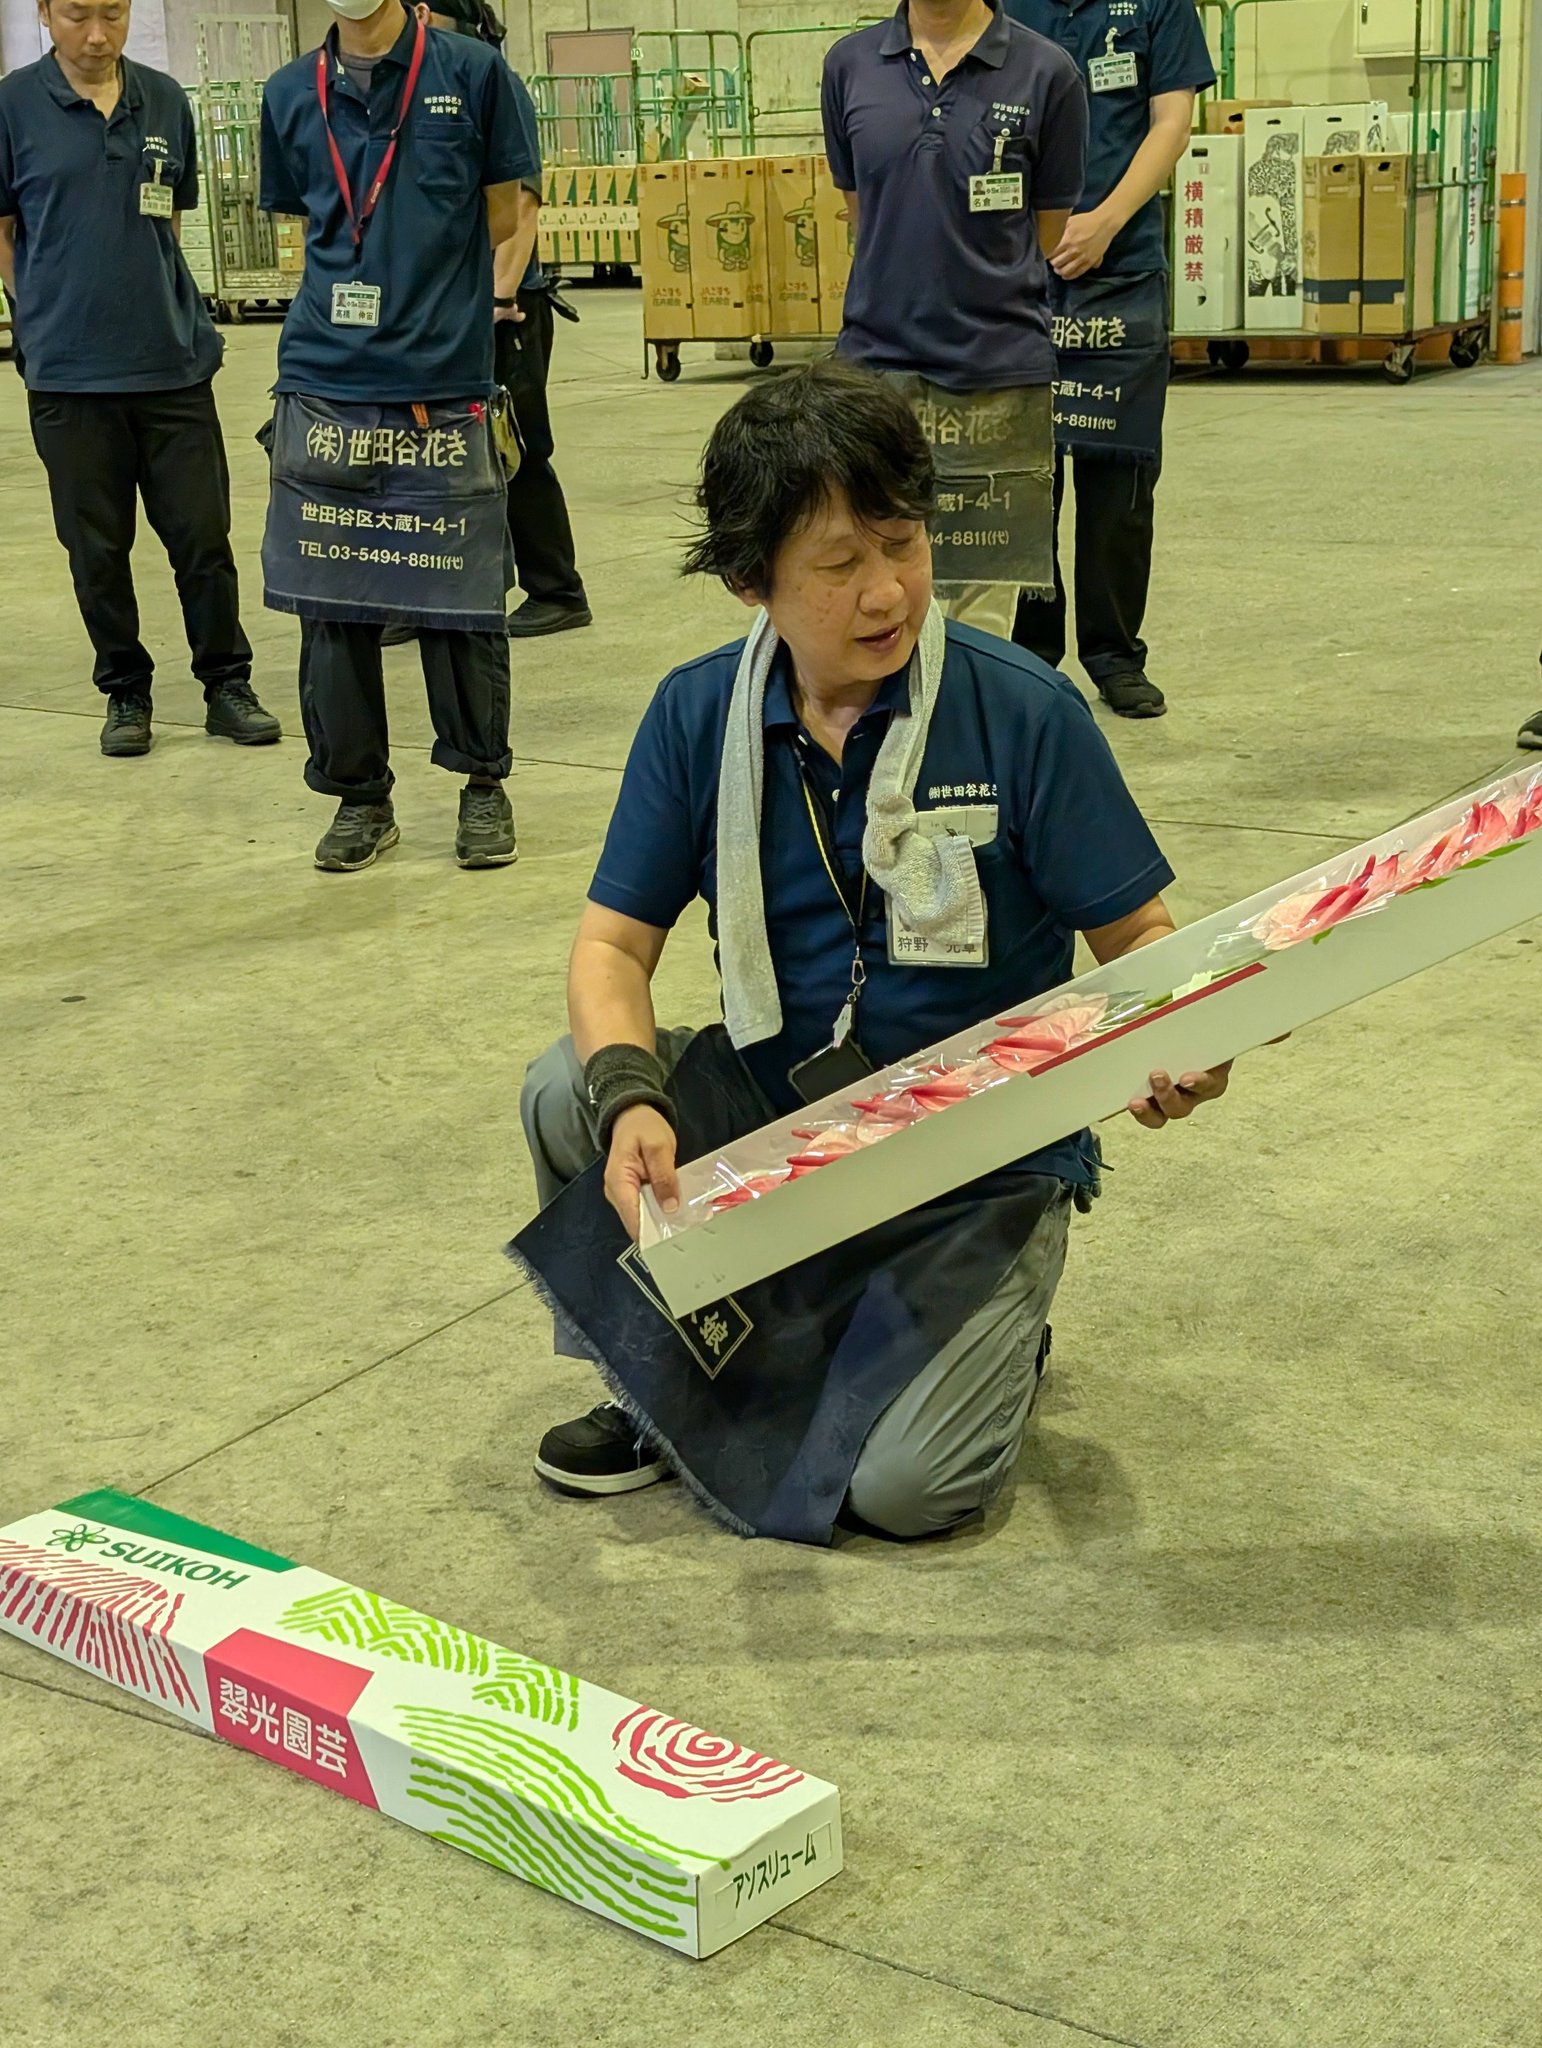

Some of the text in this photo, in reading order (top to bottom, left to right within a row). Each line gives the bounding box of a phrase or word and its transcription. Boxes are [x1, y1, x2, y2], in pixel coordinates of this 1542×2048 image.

[974, 197, 991, 208] 名倉
[1184, 181, 1205, 282] 横積厳禁
[1052, 411, 1117, 431] 4-8811(代)
[306, 421, 468, 468] (株)世田谷花き
[301, 502, 467, 537] 世田谷区大蔵1-4-1
[299, 540, 327, 559] TEL
[898, 936, 928, 952] 狩野
[98, 1542, 251, 1590] SUIKOH
[219, 1677, 348, 1779] 翠光園芸
